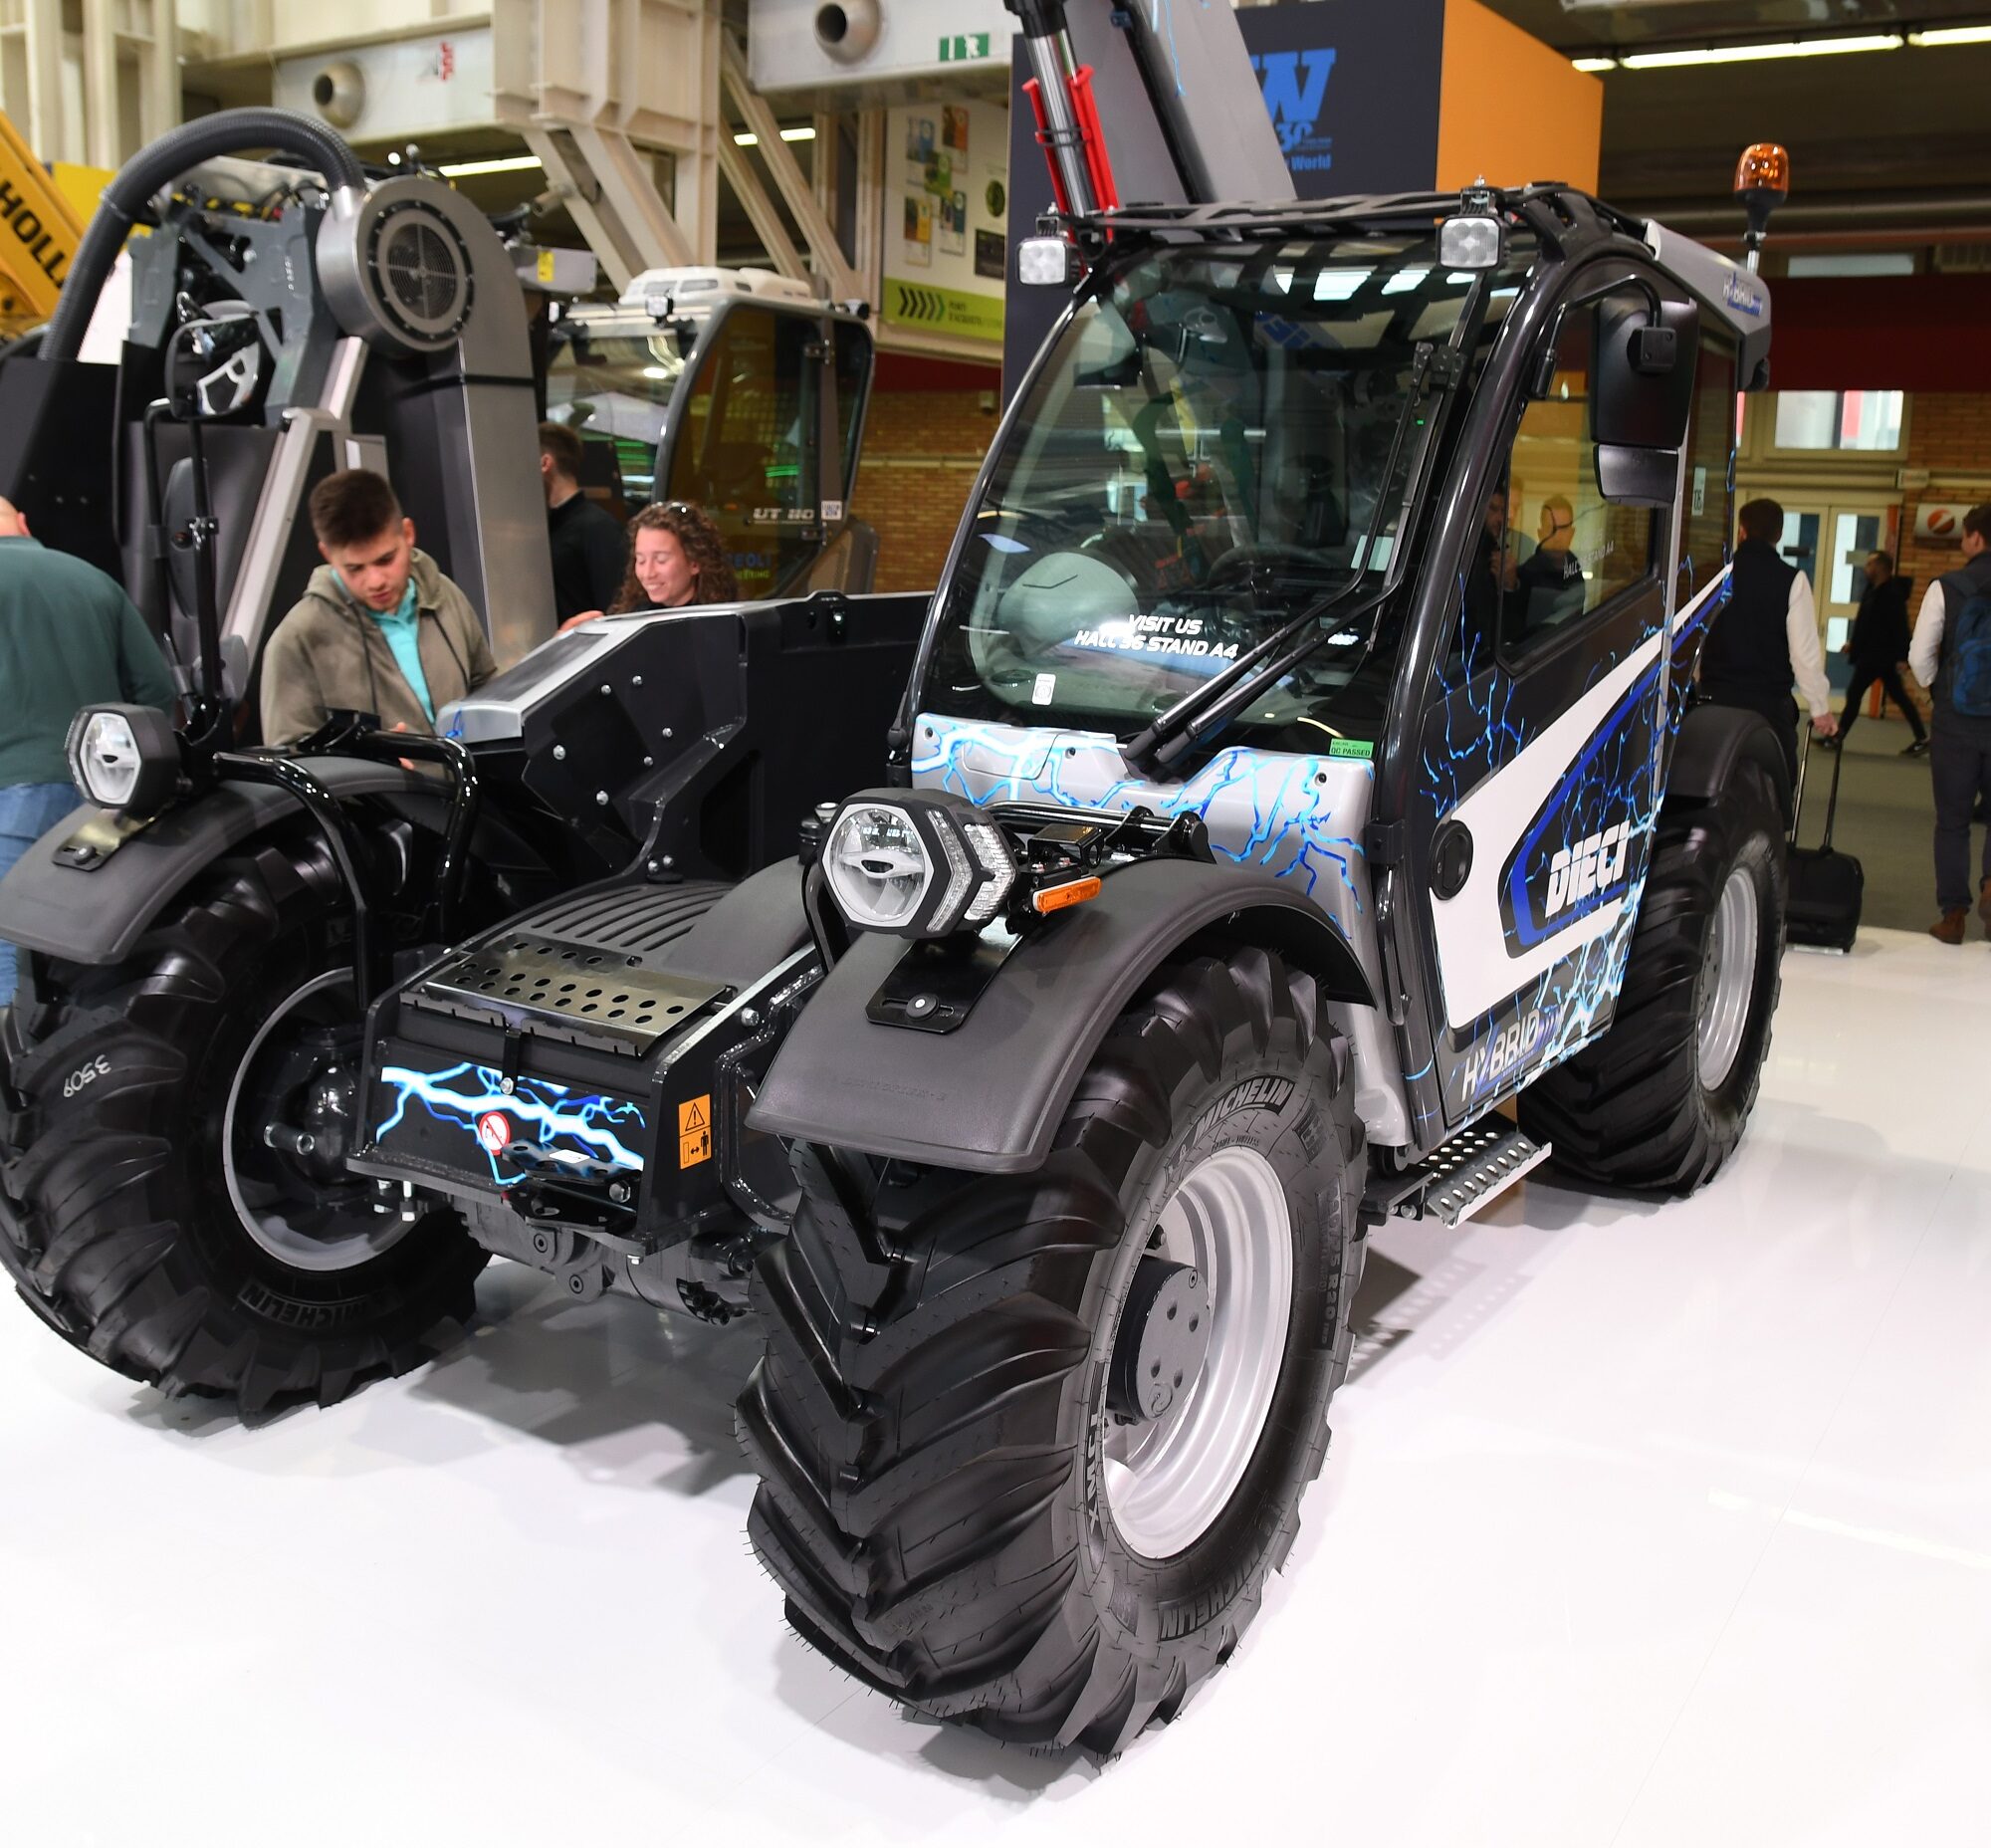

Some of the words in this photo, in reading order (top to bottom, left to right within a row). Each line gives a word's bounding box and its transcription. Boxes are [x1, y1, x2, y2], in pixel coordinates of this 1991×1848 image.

[0, 180, 65, 289] HOLL
[753, 508, 782, 519] UT
[1074, 630, 1117, 648] HALL
[1117, 634, 1146, 650] 36
[1146, 634, 1210, 656] STAND
[1209, 642, 1239, 659] A4
[1128, 614, 1175, 632] VISIT
[1175, 618, 1203, 635] US
[1342, 747, 1371, 757] PASSED
[1545, 819, 1630, 919] DIECI
[63, 1053, 111, 1098] 3509
[1461, 1009, 1540, 1102] HYBRID
[1193, 1076, 1295, 1146] MICHELIN
[239, 1282, 367, 1328] MICHELIN
[1161, 1551, 1259, 1639] MICHELIN
